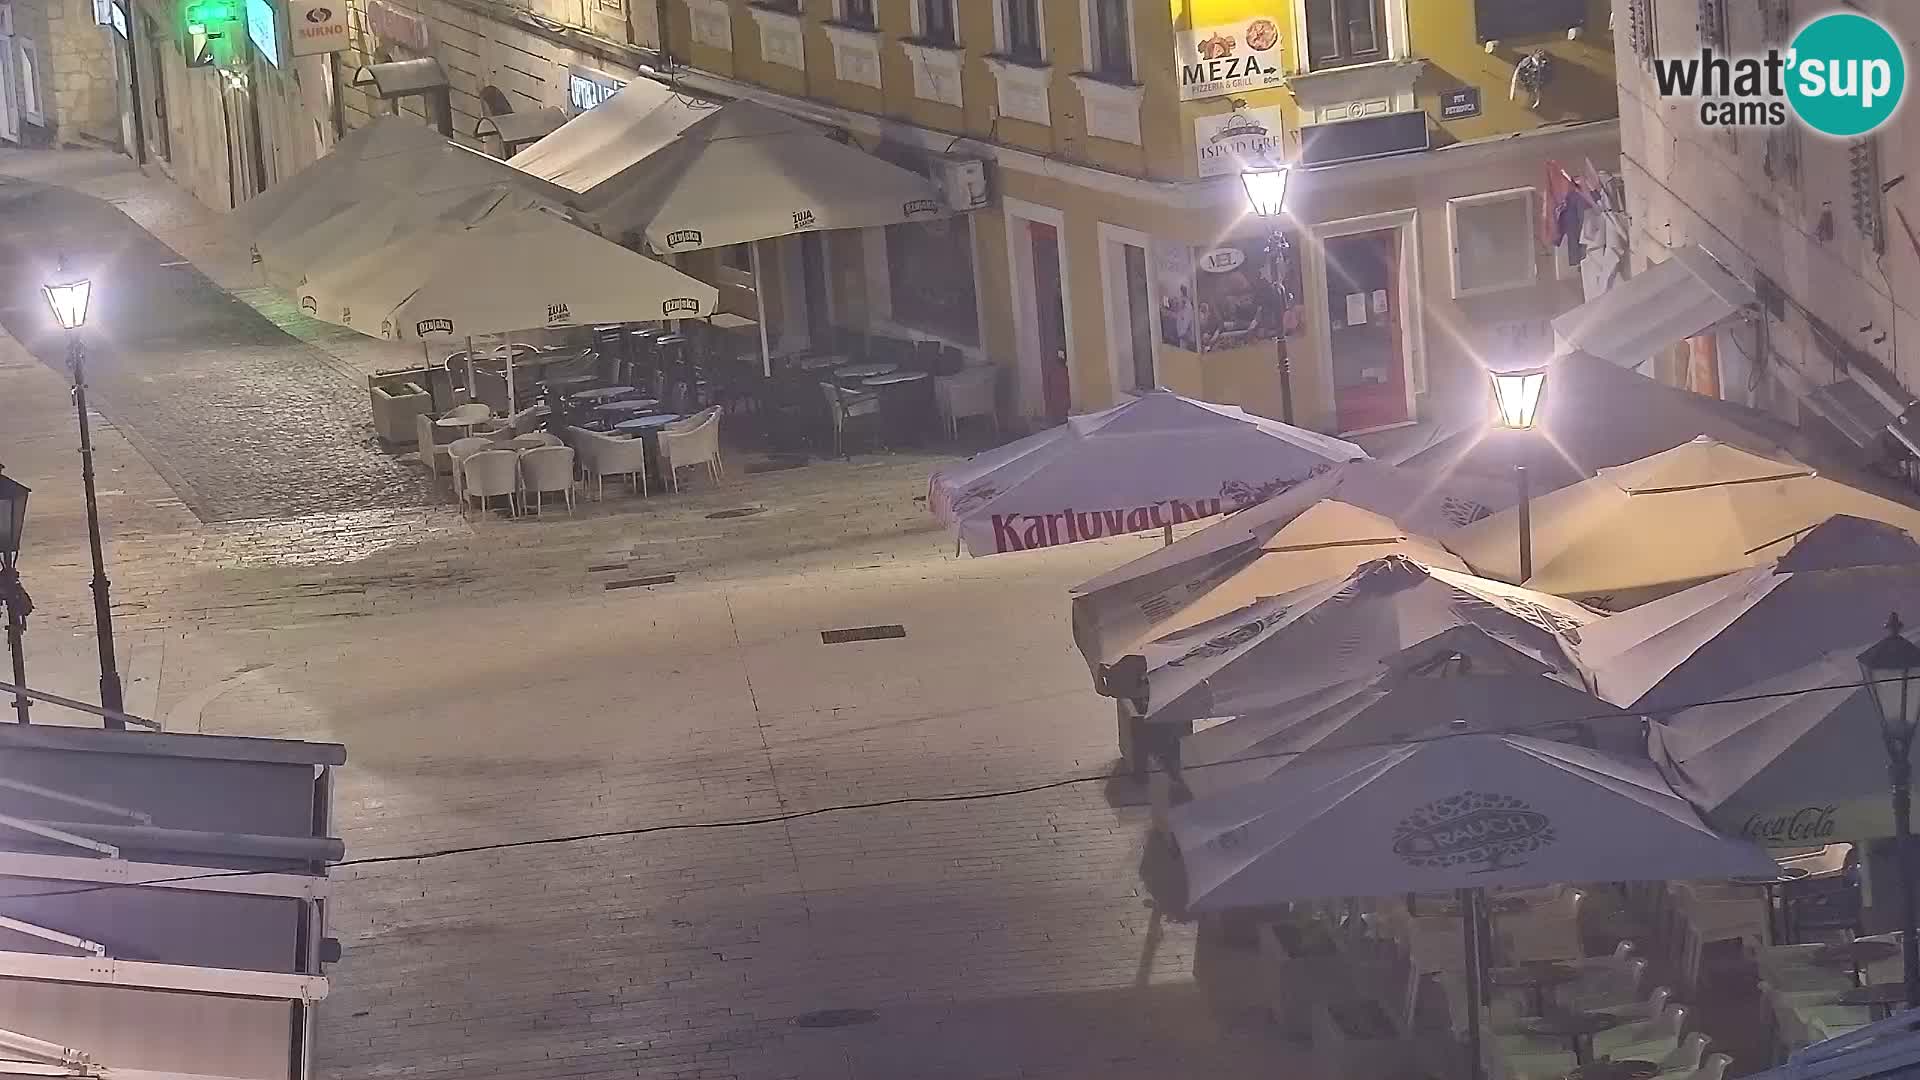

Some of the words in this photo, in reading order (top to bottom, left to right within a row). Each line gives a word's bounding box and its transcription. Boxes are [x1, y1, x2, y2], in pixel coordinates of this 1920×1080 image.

[1183, 56, 1261, 85] MEZA
[1191, 80, 1225, 94] PIZZERIA
[1232, 78, 1253, 88] GRILL
[1201, 141, 1247, 159] ISPOD
[792, 209, 813, 224] ŽUJA
[547, 303, 569, 317] ŽUJA
[1433, 815, 1530, 848] RAUCH
